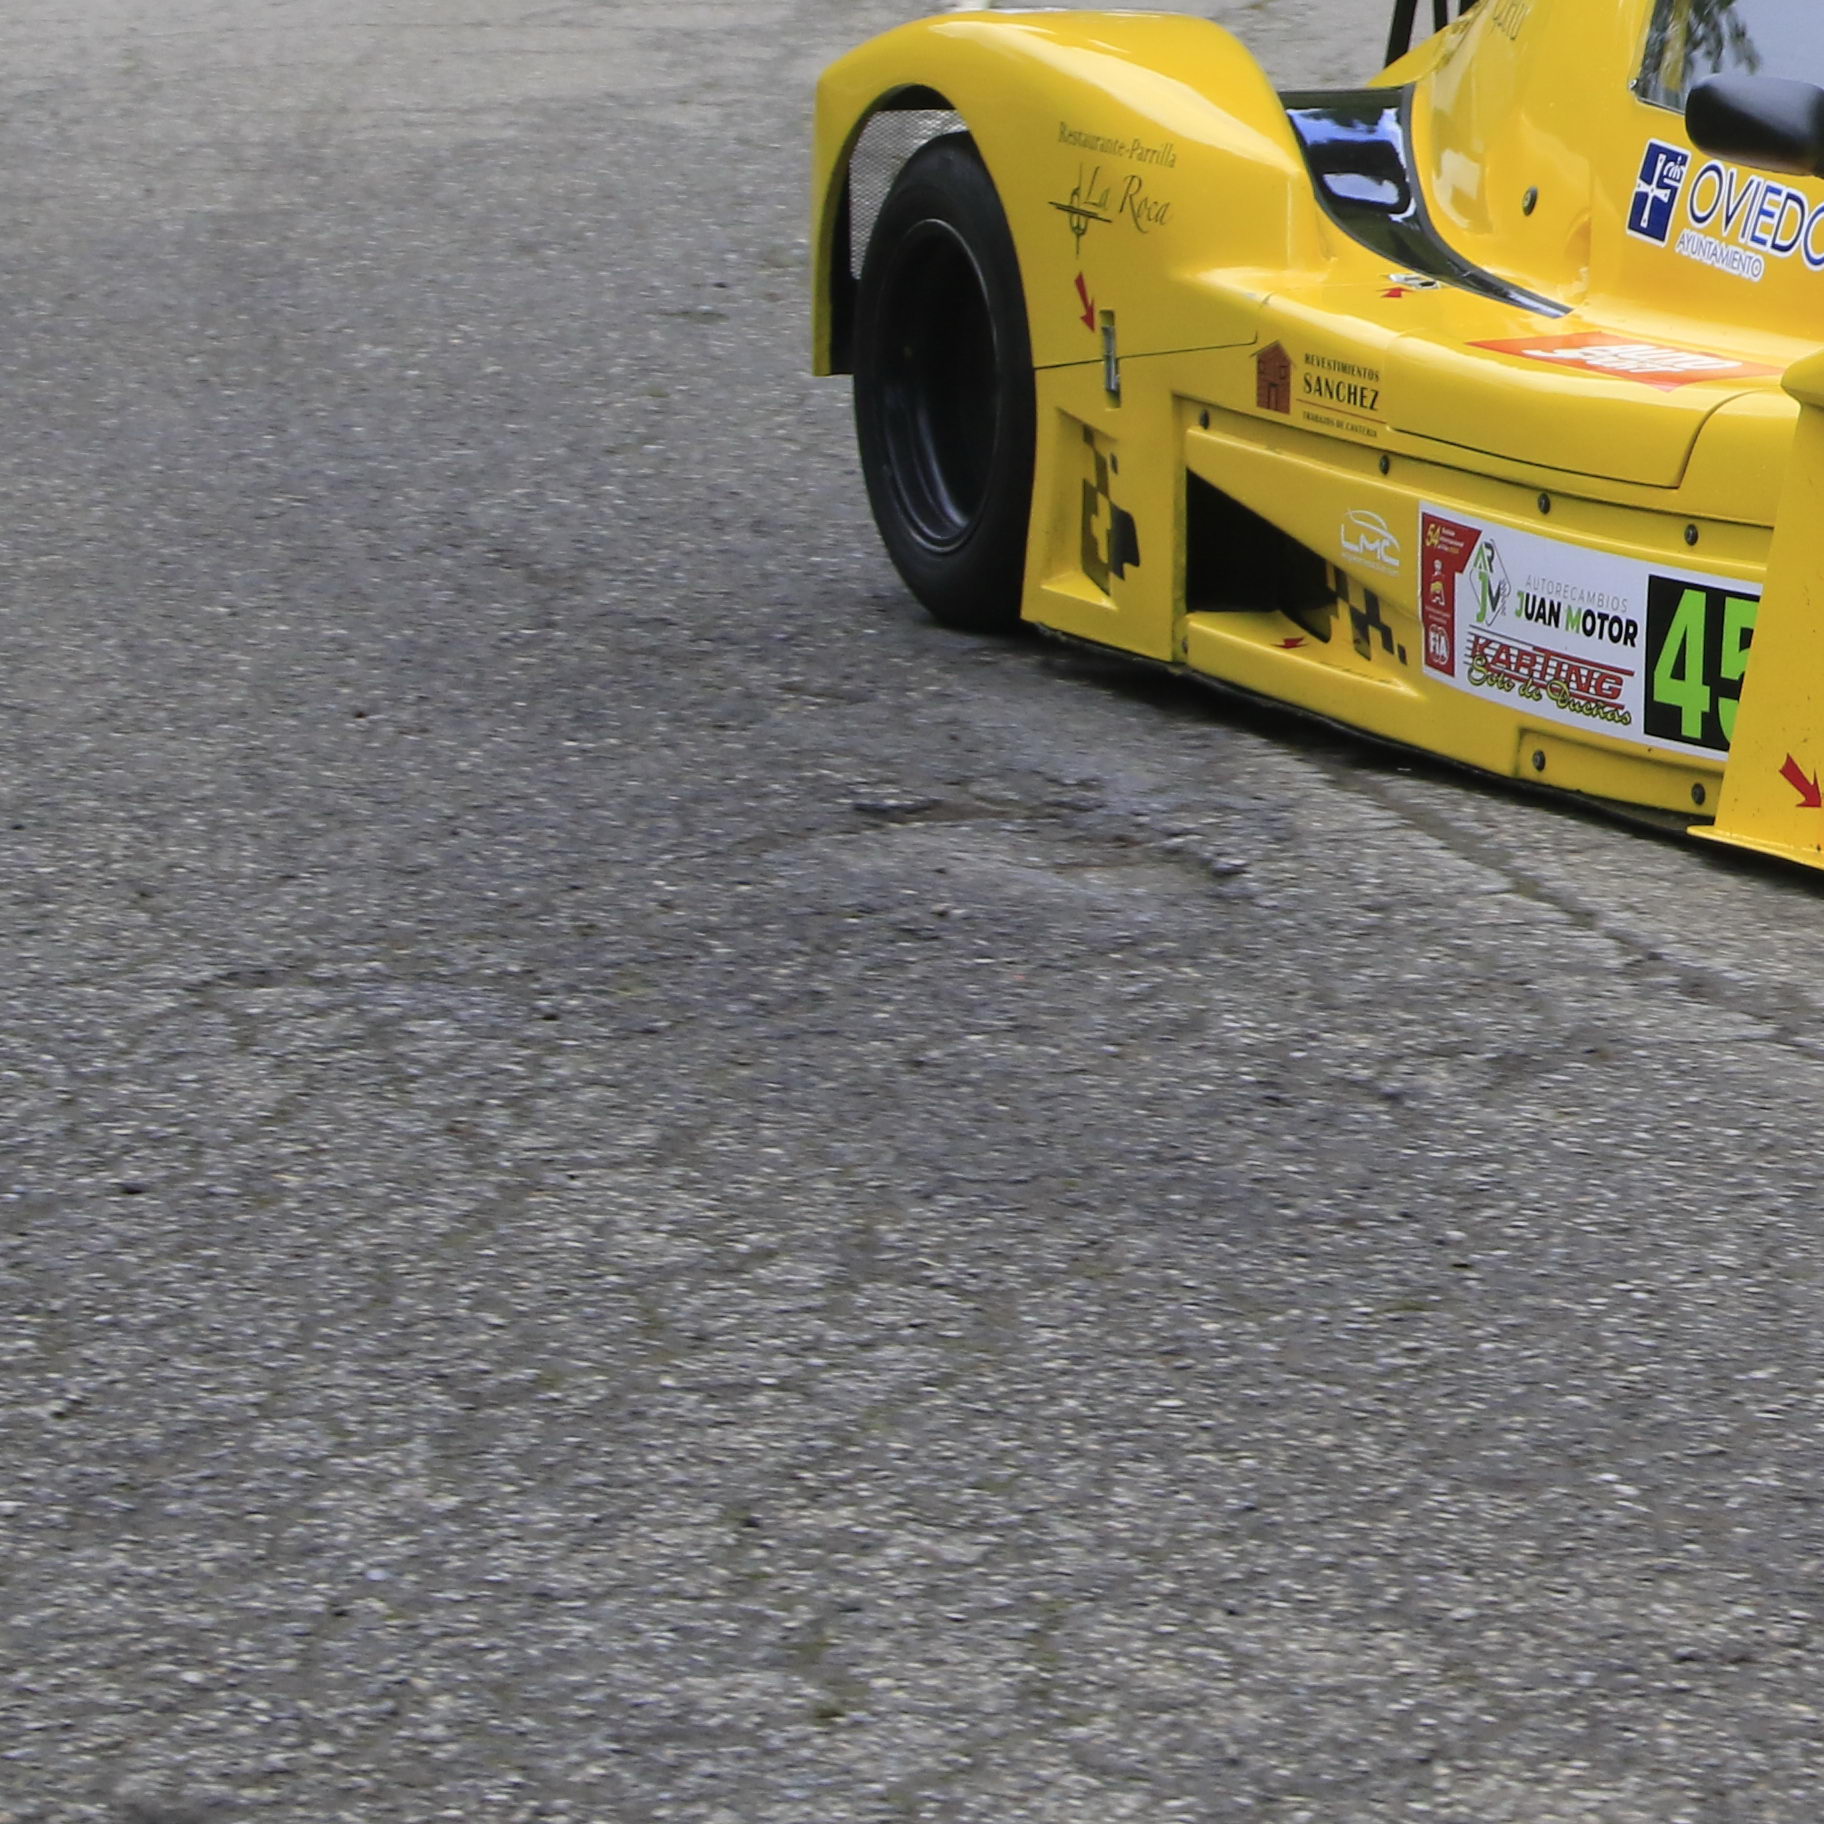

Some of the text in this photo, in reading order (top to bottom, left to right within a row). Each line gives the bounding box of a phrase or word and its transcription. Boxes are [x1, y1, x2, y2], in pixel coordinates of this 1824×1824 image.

[1083, 165, 1172, 234] La Roca
[1678, 231, 1764, 279] AYUNTAMIENTO
[1305, 353, 1380, 382] REVESTIMIENTOS
[1303, 371, 1380, 412] SANCHEZ
[1525, 575, 1628, 614] AUTORECAMBIOS
[1515, 590, 1562, 629] JUAN
[1565, 604, 1639, 648] MOTOR
[1429, 630, 1448, 660] FIA
[1471, 633, 1636, 701] KARTING
